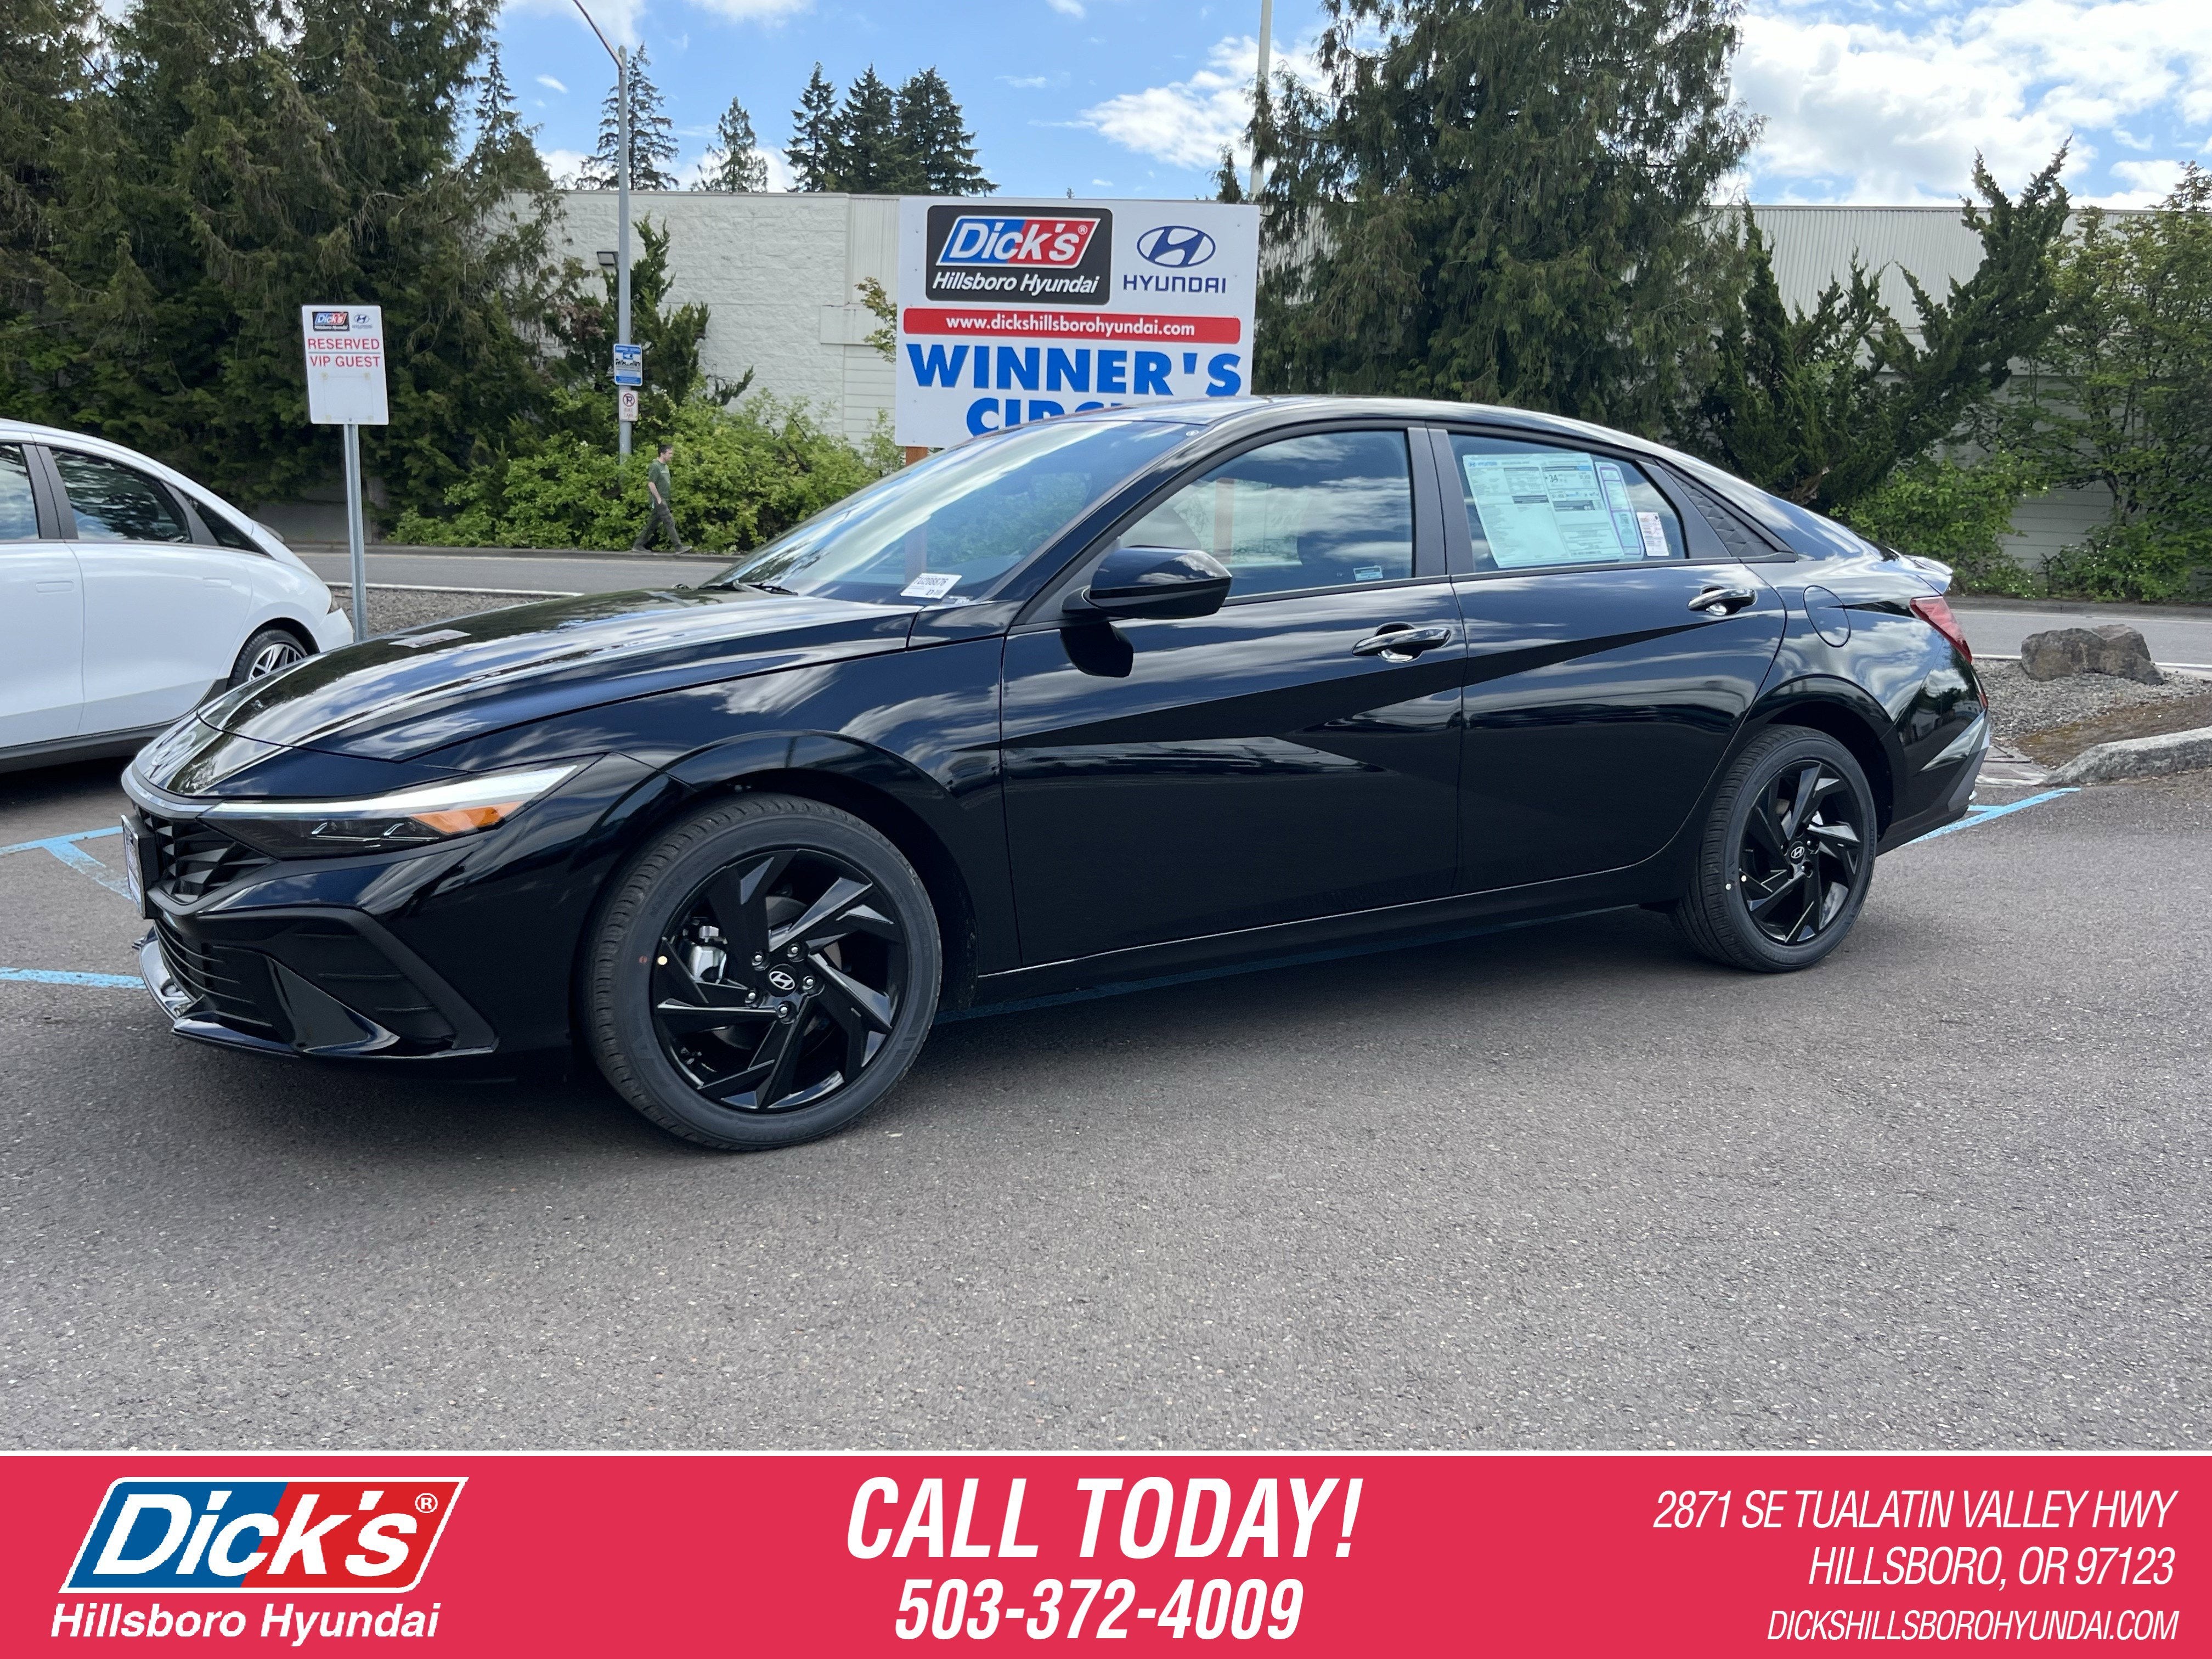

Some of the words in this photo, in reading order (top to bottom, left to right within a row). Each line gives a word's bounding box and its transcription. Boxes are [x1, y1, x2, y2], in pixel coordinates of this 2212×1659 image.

[932, 272, 1018, 291] Hillsboro
[1019, 274, 1101, 297] Hyundai
[1123, 275, 1227, 294] HYUNDAI
[946, 314, 1195, 337] www.dickshillsborohyundai.com
[308, 338, 380, 350] RESERVED
[309, 356, 330, 366] VIP
[335, 357, 380, 368] GUEST
[906, 343, 1242, 396] WINNER'S
